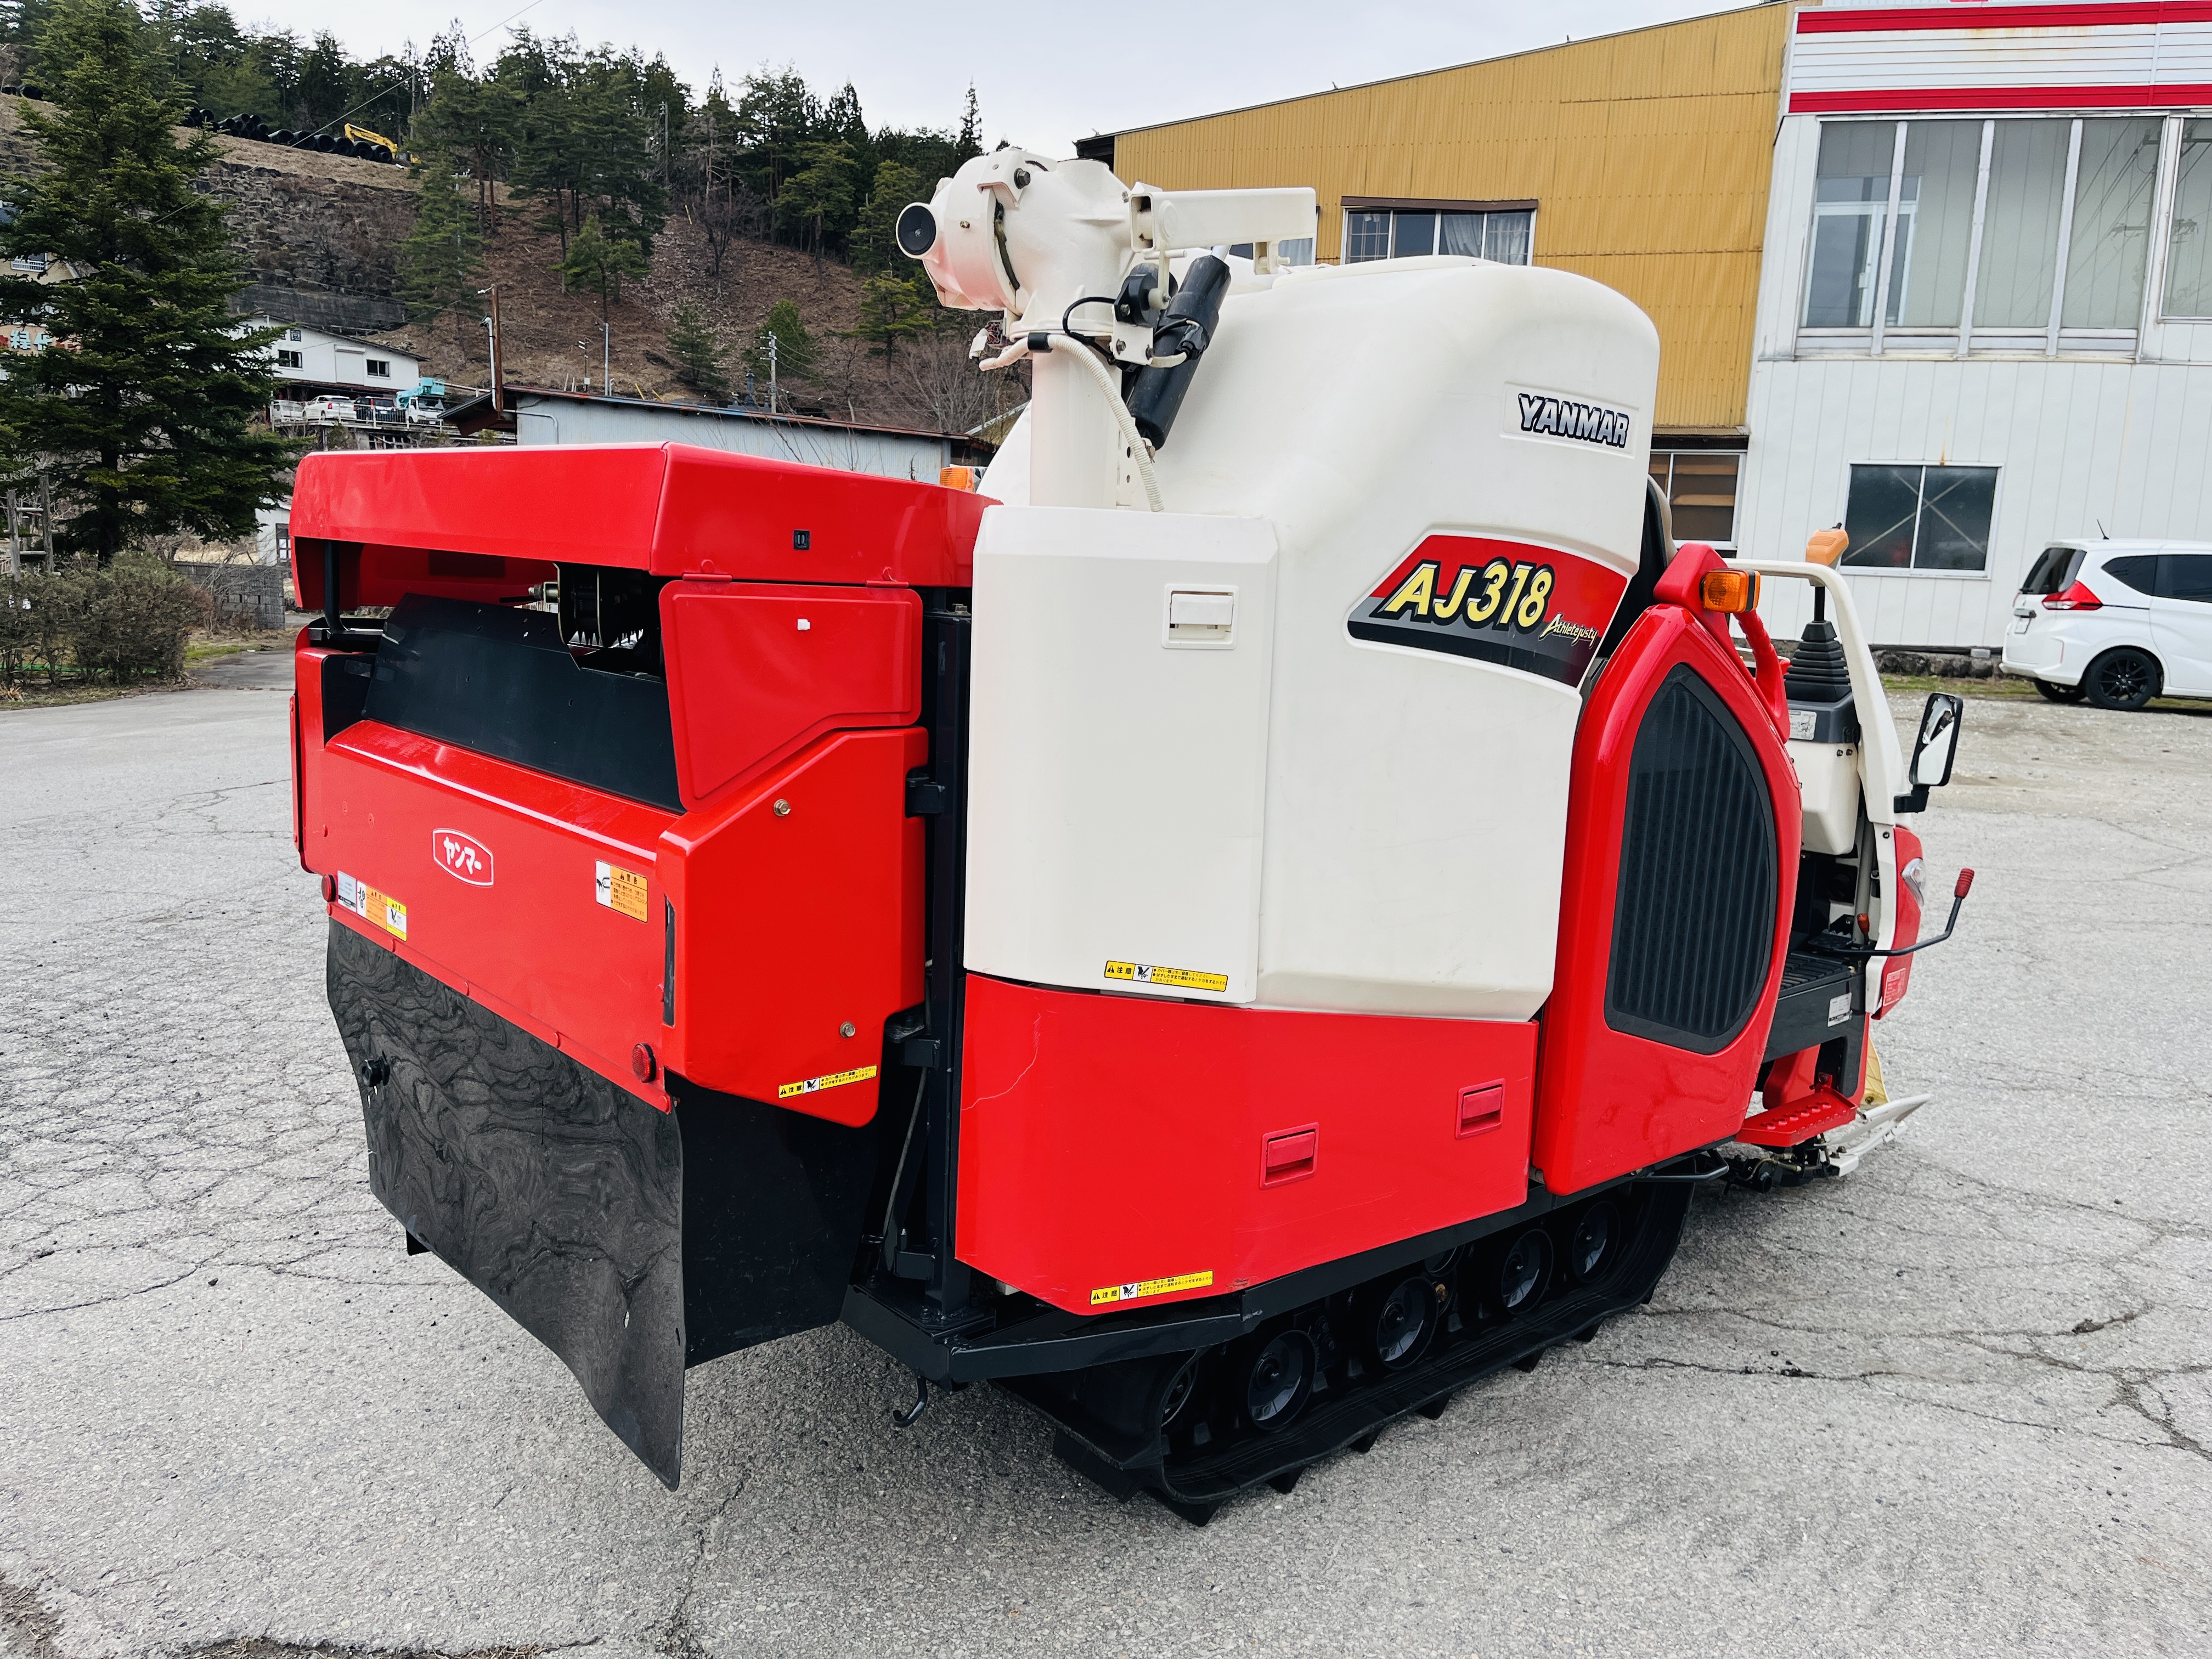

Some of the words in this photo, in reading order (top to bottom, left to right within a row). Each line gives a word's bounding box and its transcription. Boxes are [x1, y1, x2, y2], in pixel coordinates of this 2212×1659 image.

[1518, 393, 1629, 448] YANMAR
[1372, 558, 1554, 630] AJ318
[443, 836, 482, 874] ヤンマー
[1116, 966, 1131, 974] 注意
[1102, 1290, 1118, 1298] 注意
